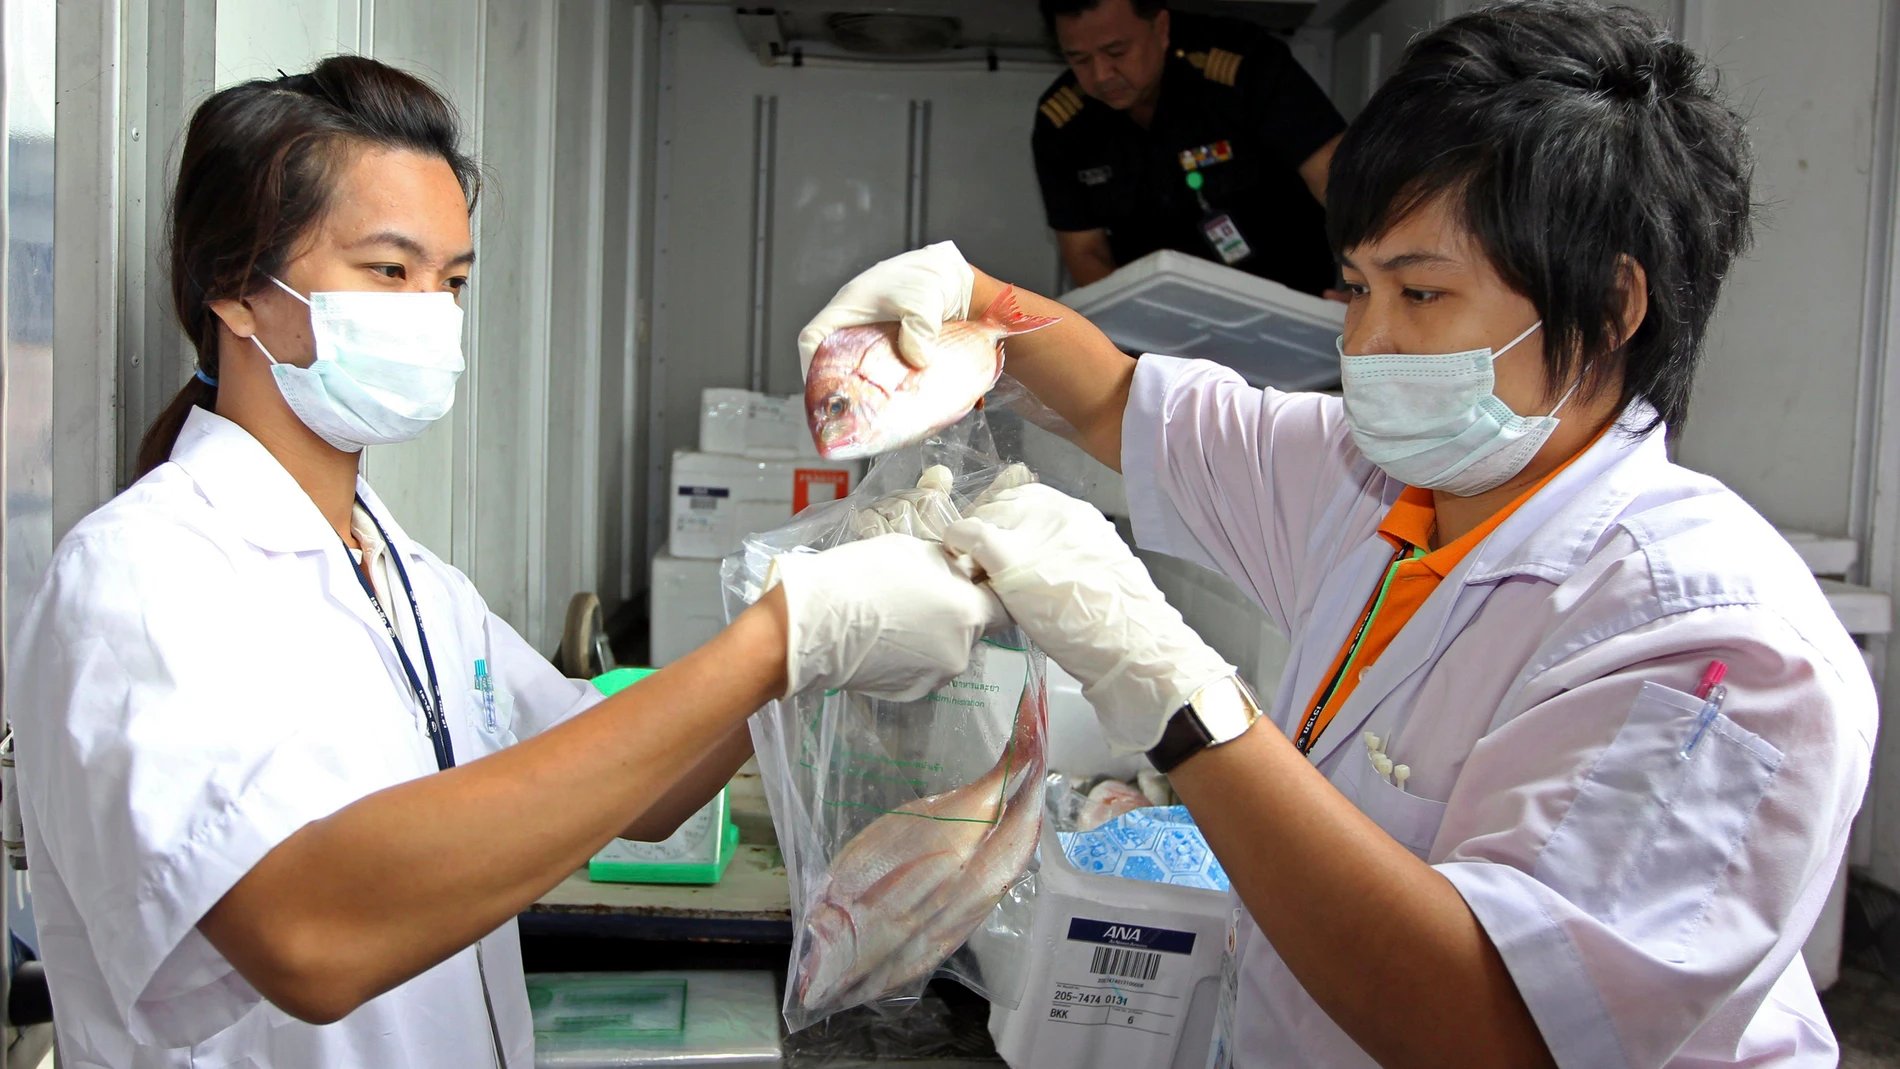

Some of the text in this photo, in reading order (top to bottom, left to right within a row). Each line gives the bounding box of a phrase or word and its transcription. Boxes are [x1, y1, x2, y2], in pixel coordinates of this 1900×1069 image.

[1102, 925, 1142, 942] ANA
[1054, 990, 1101, 1004] 205-7474
[1050, 1008, 1069, 1019] BKK
[1127, 1015, 1134, 1025] 6
